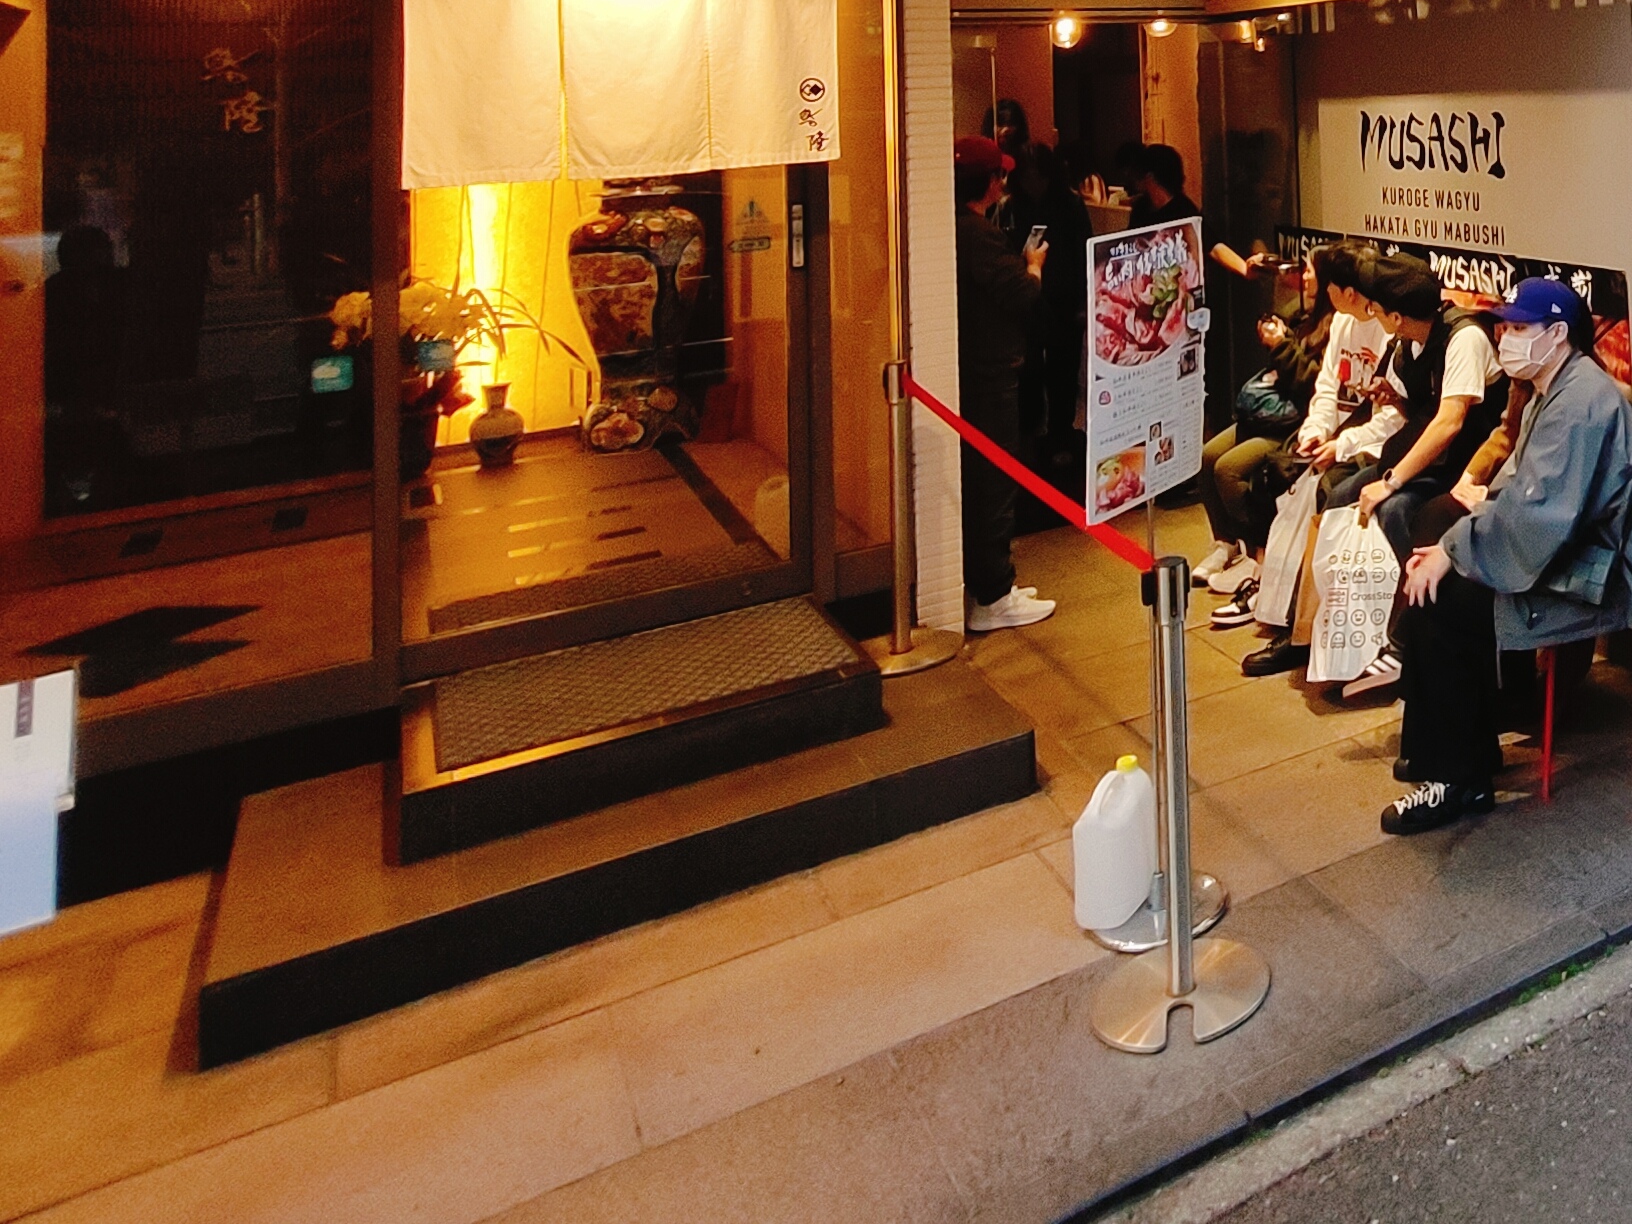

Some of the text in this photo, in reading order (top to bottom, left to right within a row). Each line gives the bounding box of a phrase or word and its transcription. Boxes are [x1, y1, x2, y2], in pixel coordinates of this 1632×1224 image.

[1360, 110, 1506, 179] MUSASHI
[1382, 186, 1480, 212] KUROGE WAGYU
[1364, 214, 1505, 247] HAKATA GYU MABUSHI
